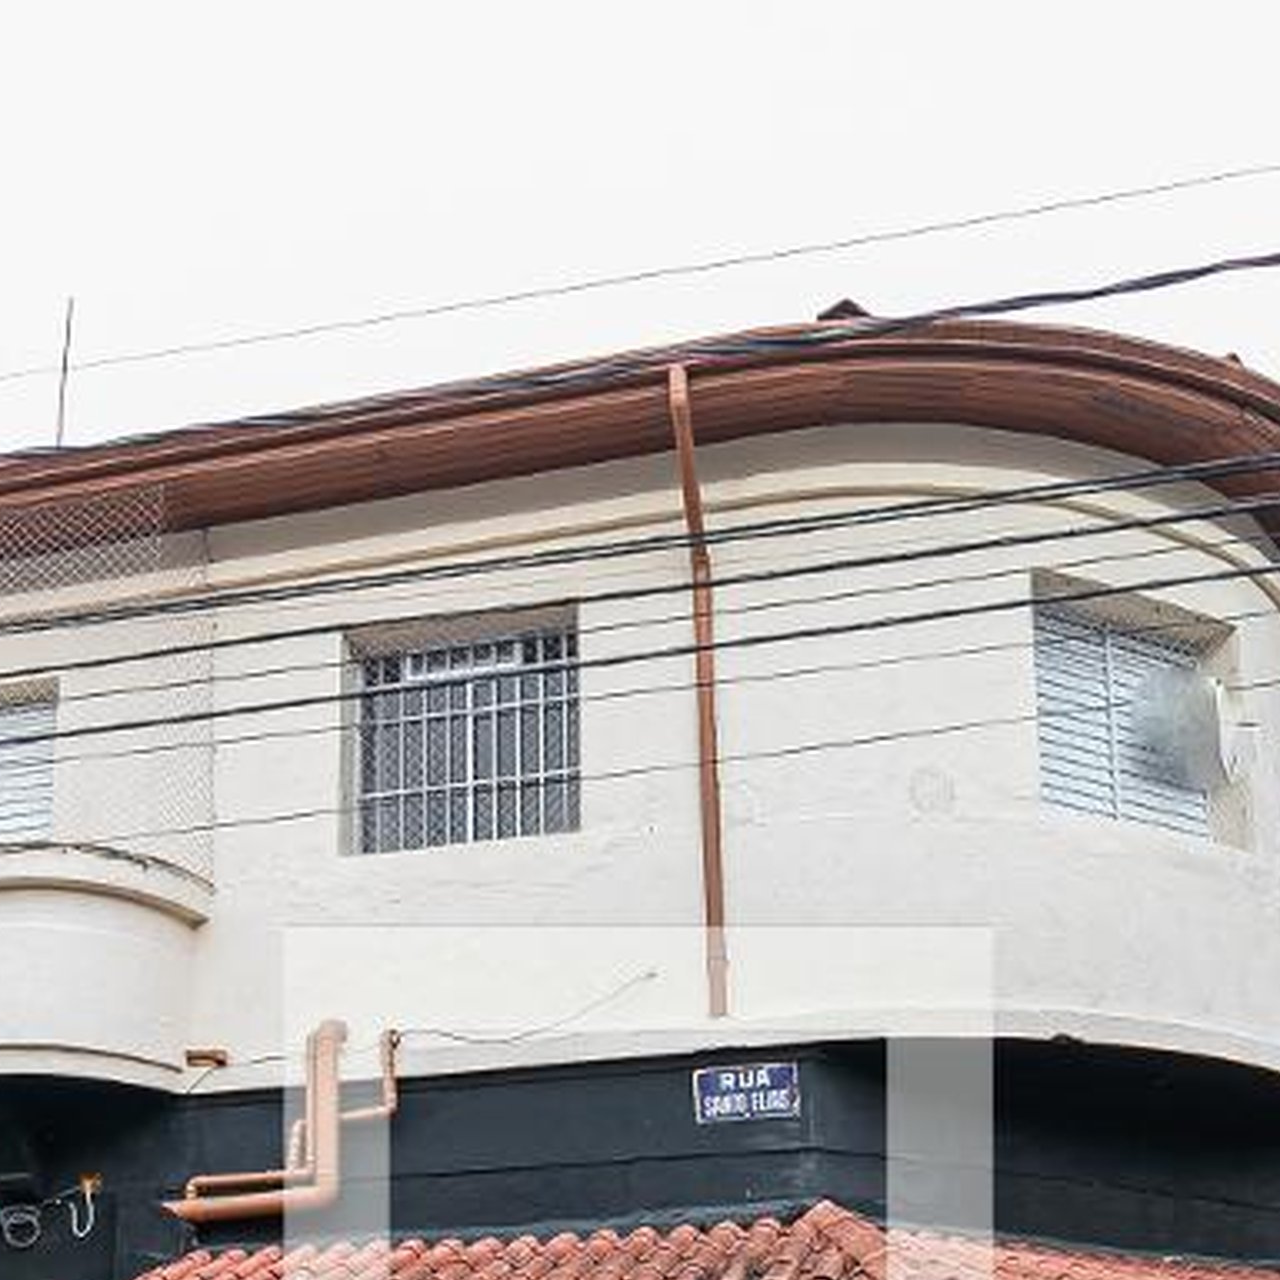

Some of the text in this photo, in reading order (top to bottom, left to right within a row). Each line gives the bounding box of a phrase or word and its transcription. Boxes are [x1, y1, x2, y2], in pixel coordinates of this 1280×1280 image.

[720, 1069, 771, 1090] RUA
[704, 1089, 790, 1117] SANTO ELIAS
